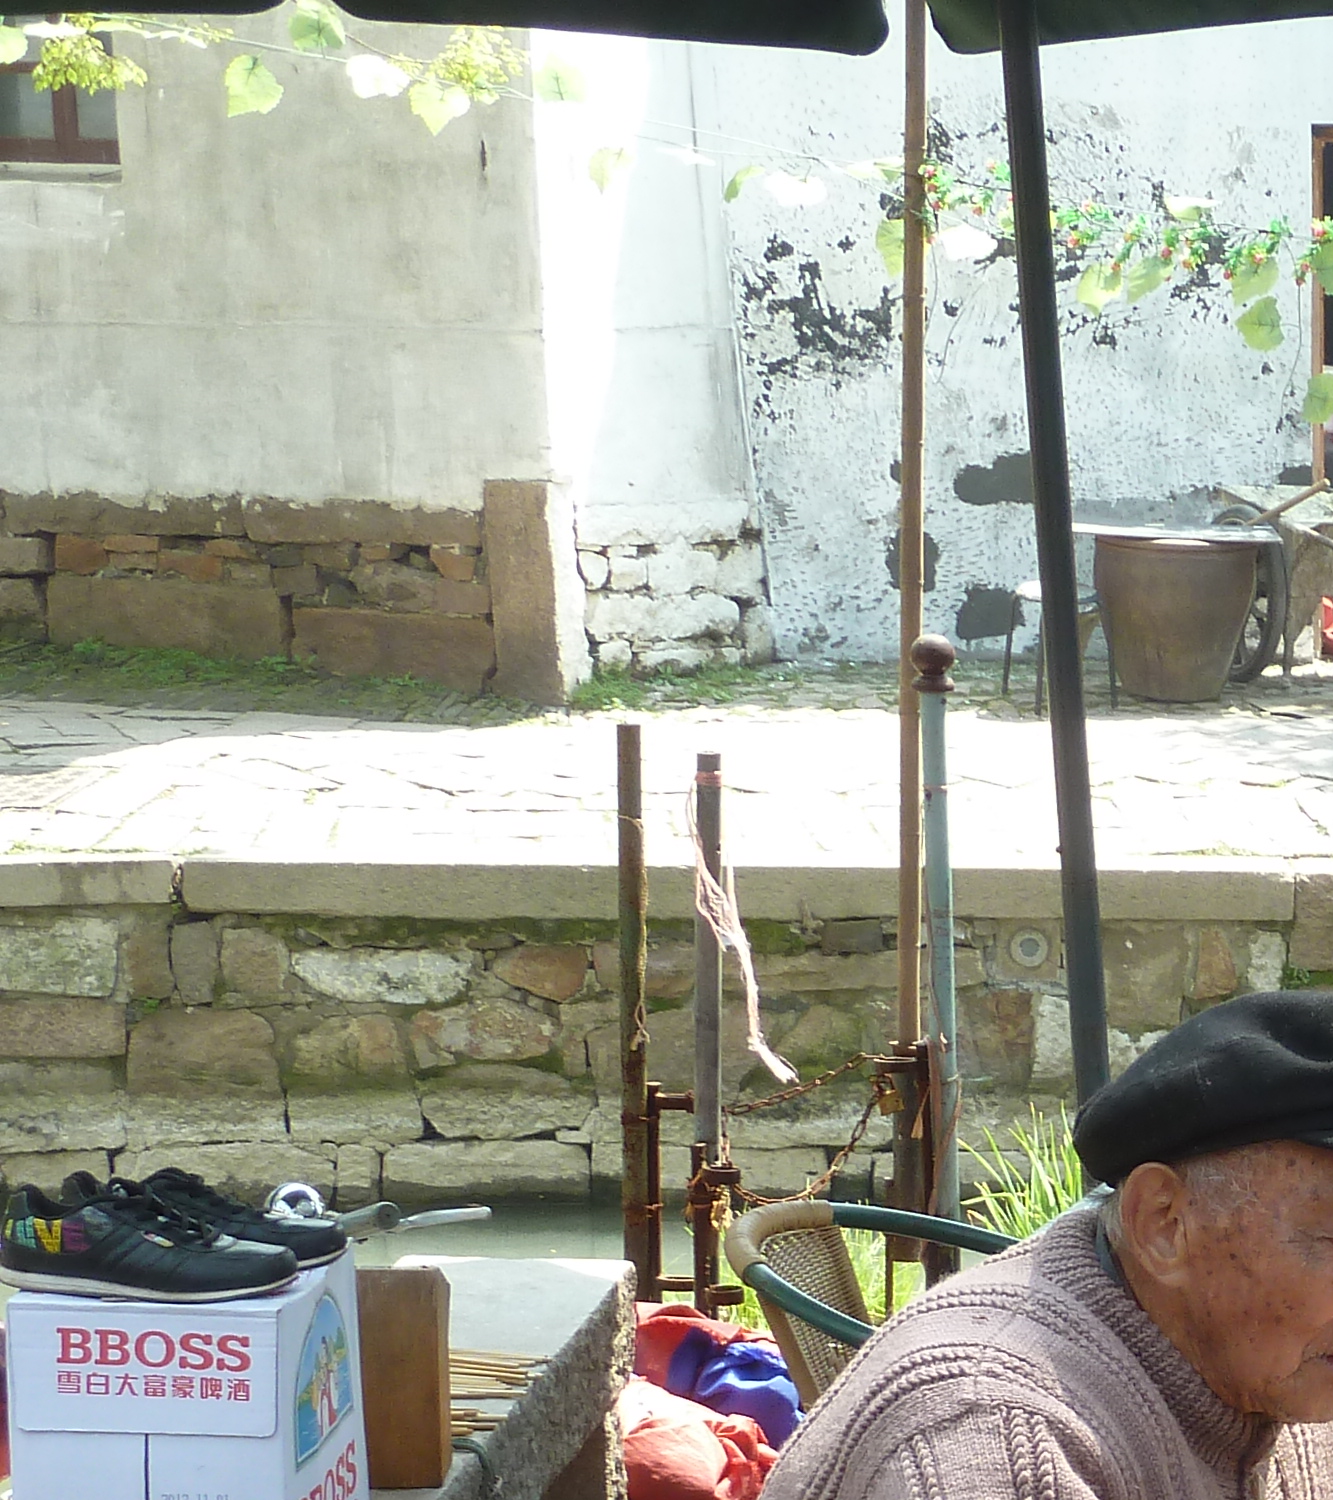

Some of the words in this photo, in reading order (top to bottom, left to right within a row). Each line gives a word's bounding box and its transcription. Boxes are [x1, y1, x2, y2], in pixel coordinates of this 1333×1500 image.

[56, 1327, 252, 1372] BBOSS
[57, 1370, 251, 1402] 雪白大富豪啤酒
